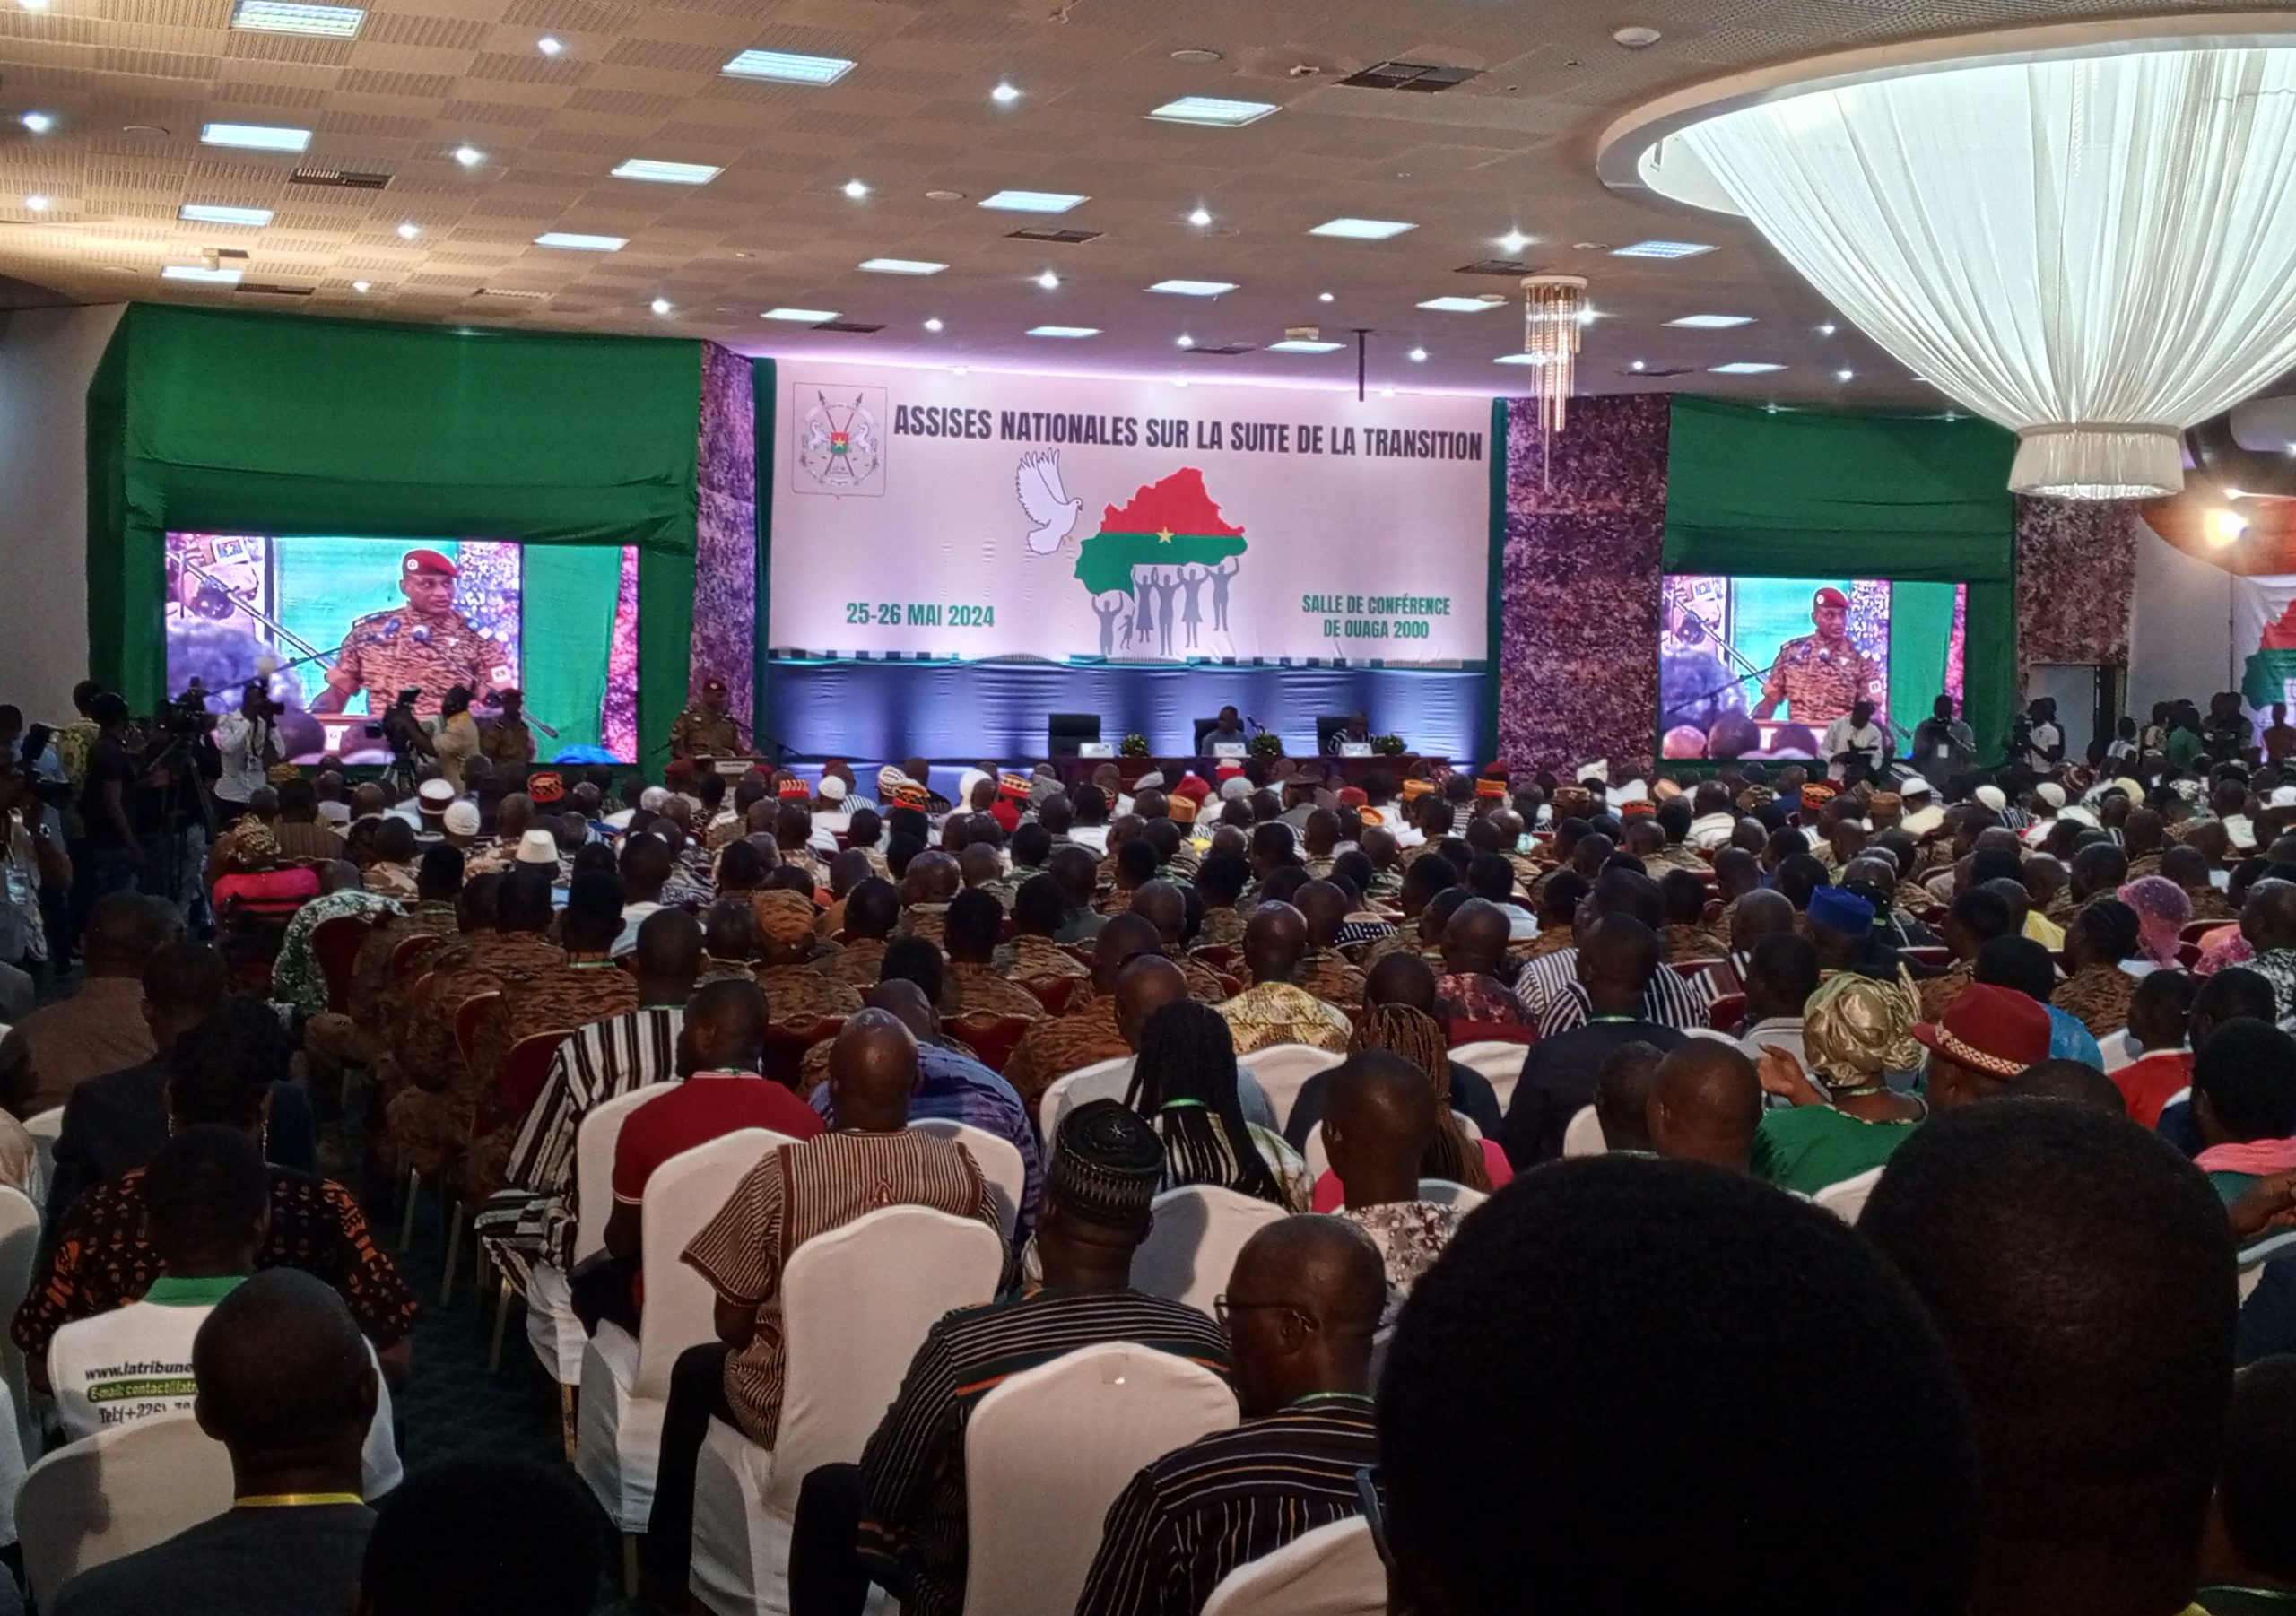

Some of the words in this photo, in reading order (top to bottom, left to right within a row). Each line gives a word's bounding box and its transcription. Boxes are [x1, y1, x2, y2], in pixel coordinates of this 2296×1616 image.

[894, 404, 992, 439] ASSISES
[1001, 411, 1138, 447] NATIONALES
[1146, 418, 1189, 449] SUR
[1197, 420, 1223, 450] LA
[1231, 421, 1290, 453] SUITE
[1297, 424, 1323, 455] DE
[1331, 426, 1356, 456] LA
[1364, 428, 1483, 461] TRANSITION
[846, 603, 901, 625] 25-26
[908, 604, 942, 626] MAI
[948, 605, 995, 628] 2024
[1302, 595, 1343, 613] SALLE
[1347, 595, 1363, 614] DE
[1368, 594, 1450, 615] CONFÉRENCE
[1324, 619, 1341, 638] DE
[1344, 620, 1388, 639] OUAGA
[1394, 621, 1430, 639] 2000
